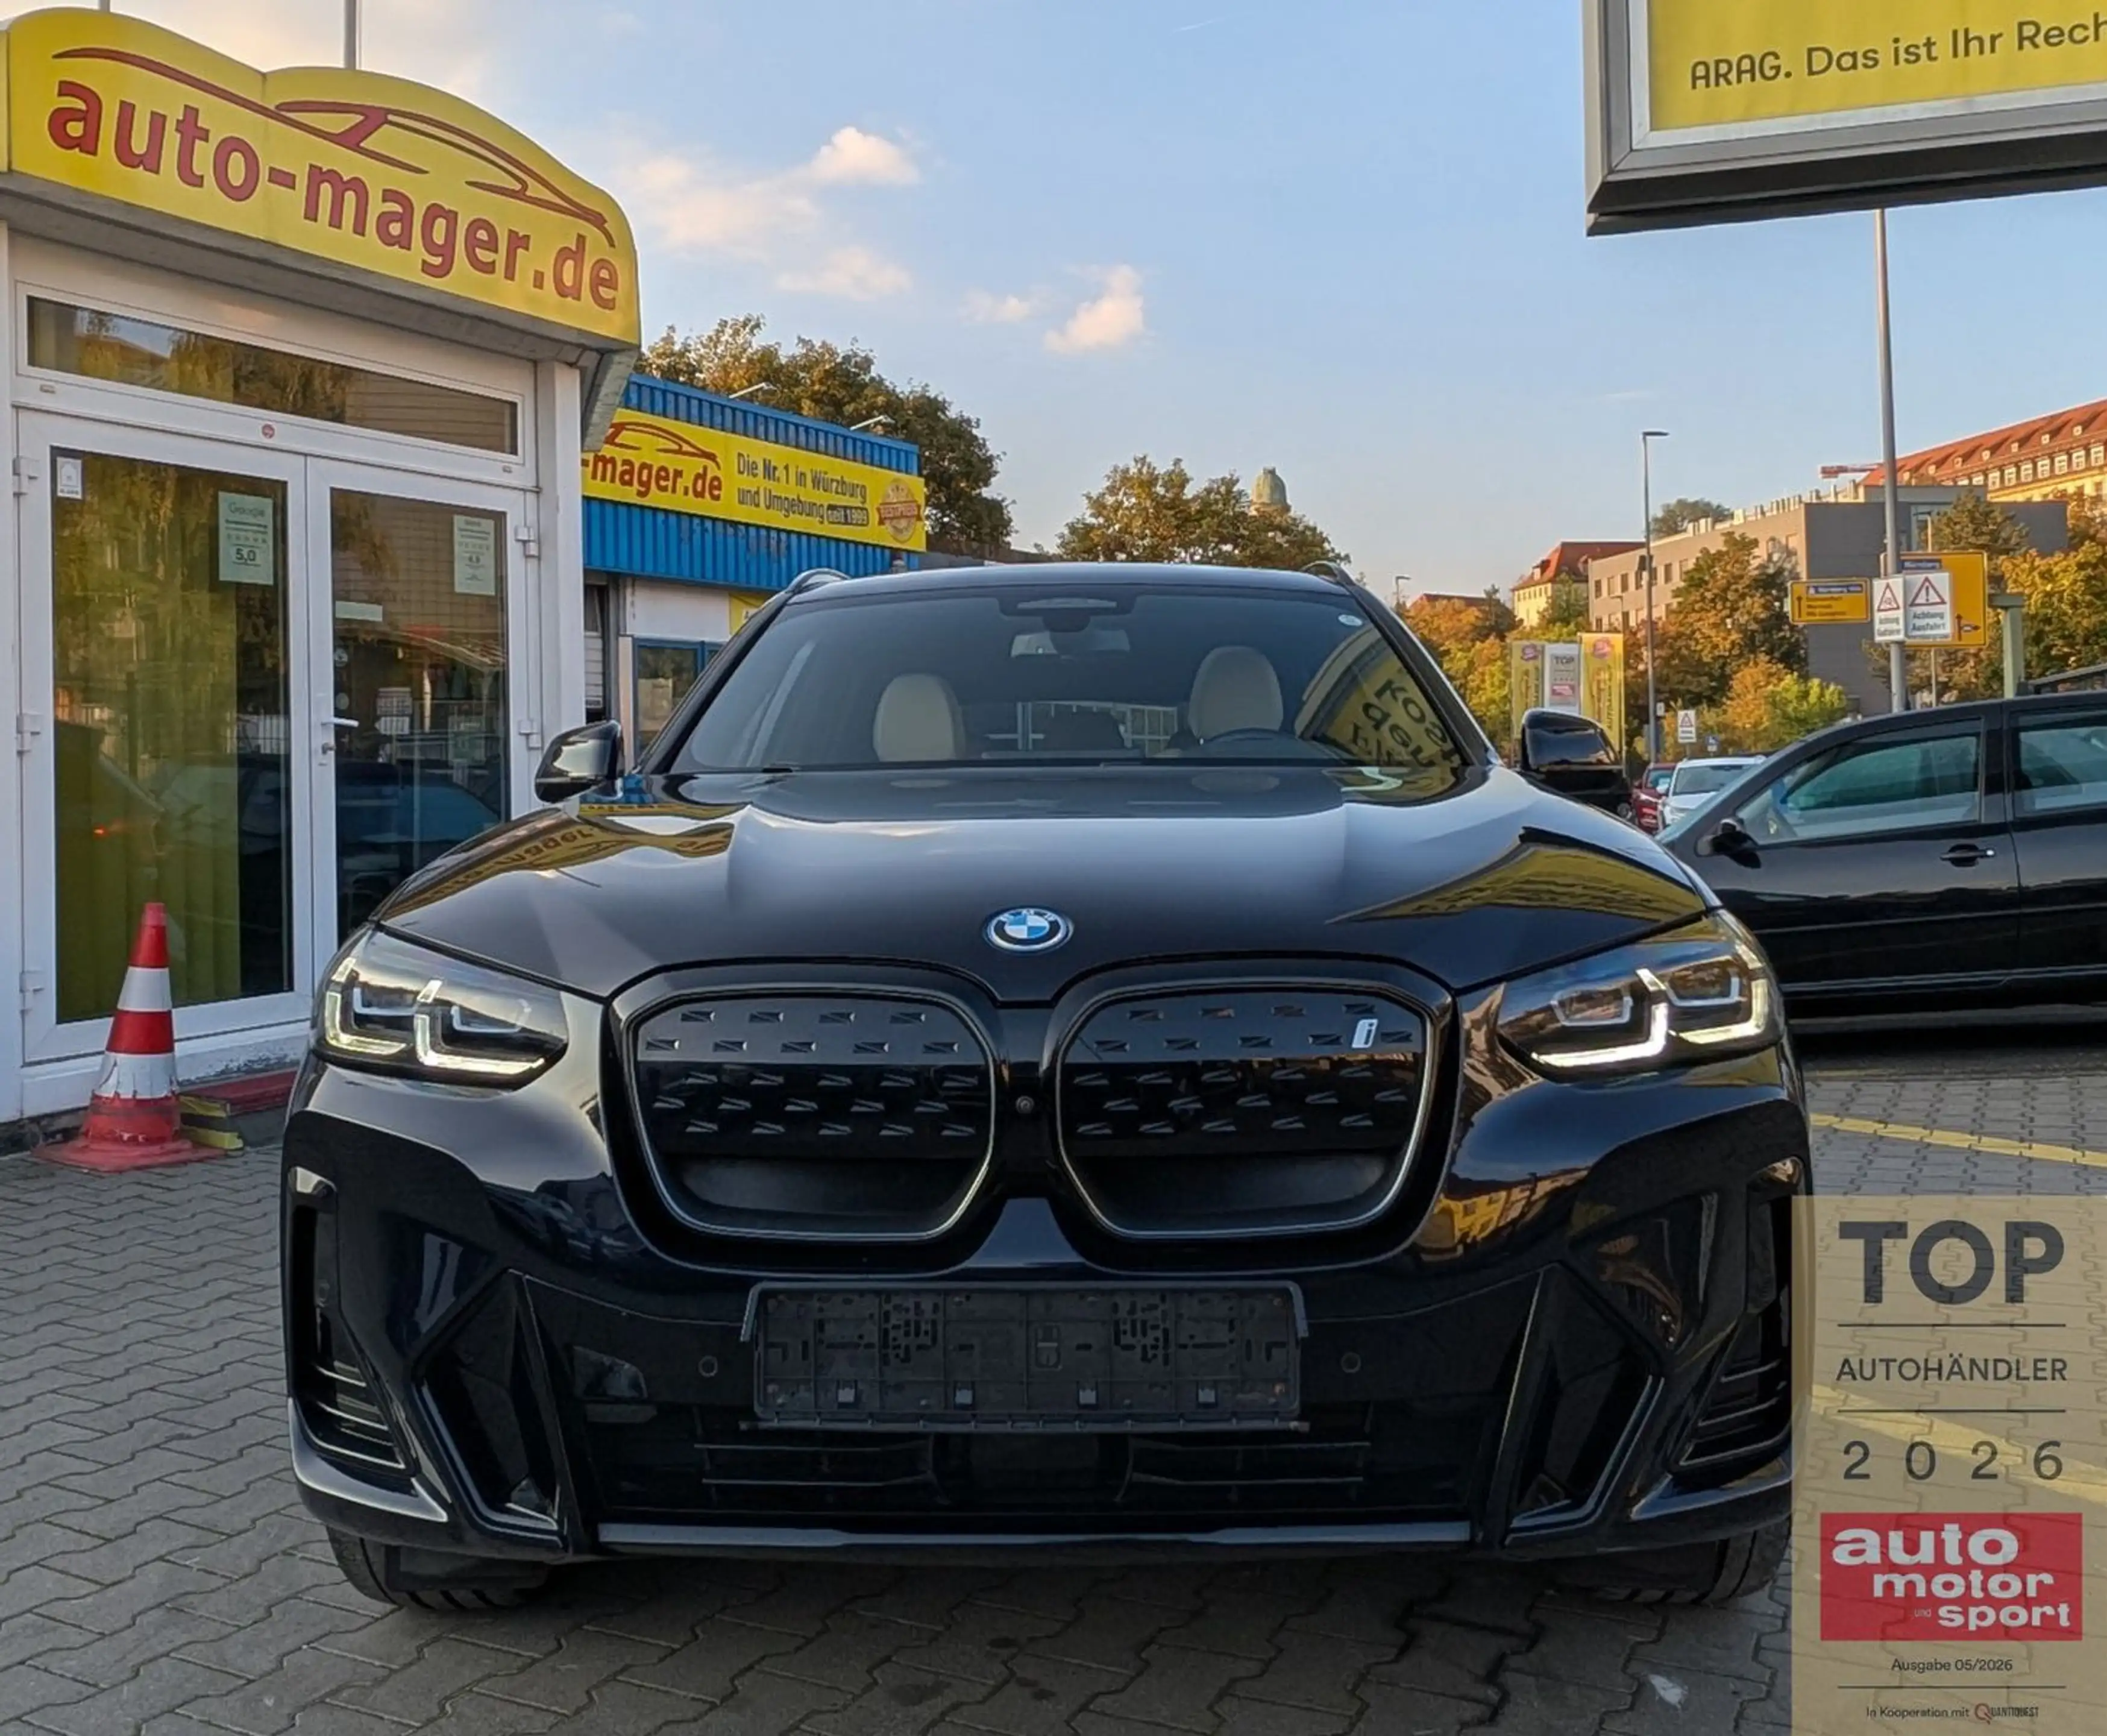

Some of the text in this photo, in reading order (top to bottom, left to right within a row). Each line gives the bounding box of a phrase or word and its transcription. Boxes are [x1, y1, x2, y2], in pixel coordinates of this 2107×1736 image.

[1691, 11, 2107, 90] ARAG. Das ist Ihr Rech
[48, 80, 619, 310] auto-mager.de
[737, 452, 867, 503] Die Nr. 1 in Würzburg
[738, 486, 760, 508] und
[764, 487, 824, 524] Umgebung
